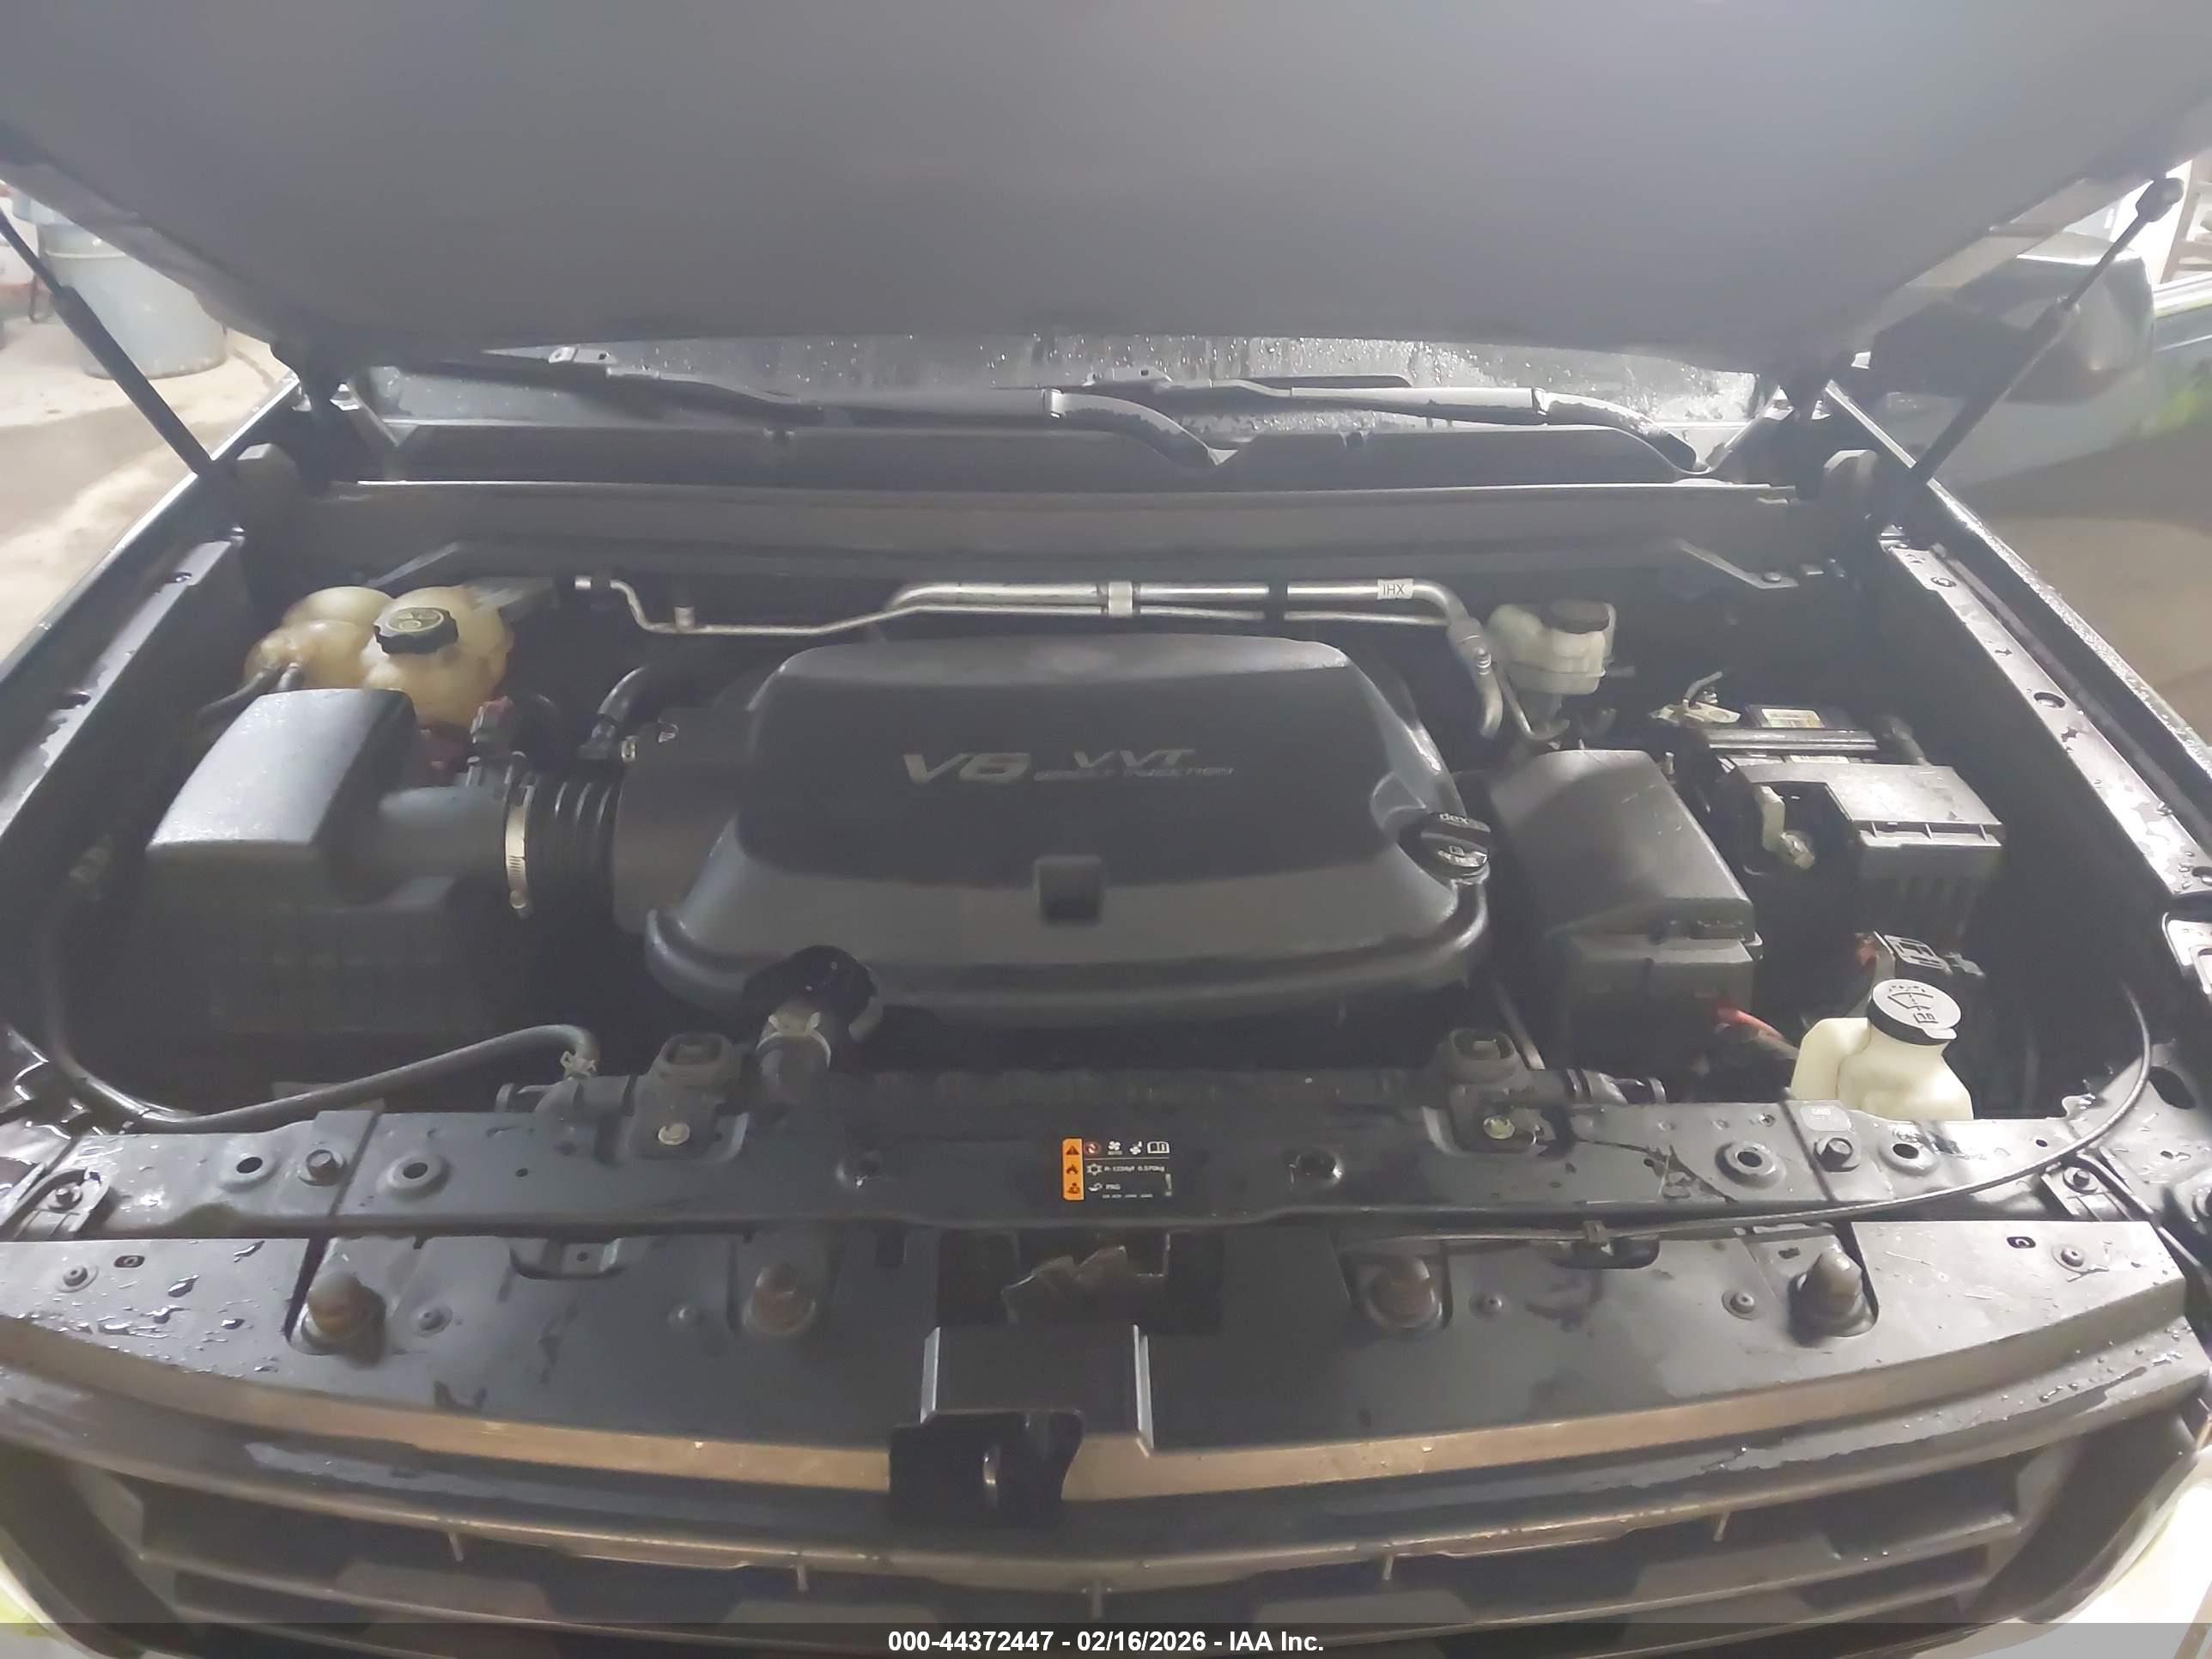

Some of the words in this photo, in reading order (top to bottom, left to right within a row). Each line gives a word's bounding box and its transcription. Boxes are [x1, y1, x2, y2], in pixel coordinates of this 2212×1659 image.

[1382, 583, 1405, 596] IHX
[903, 751, 1030, 784] V6
[1073, 748, 1196, 768] VVT
